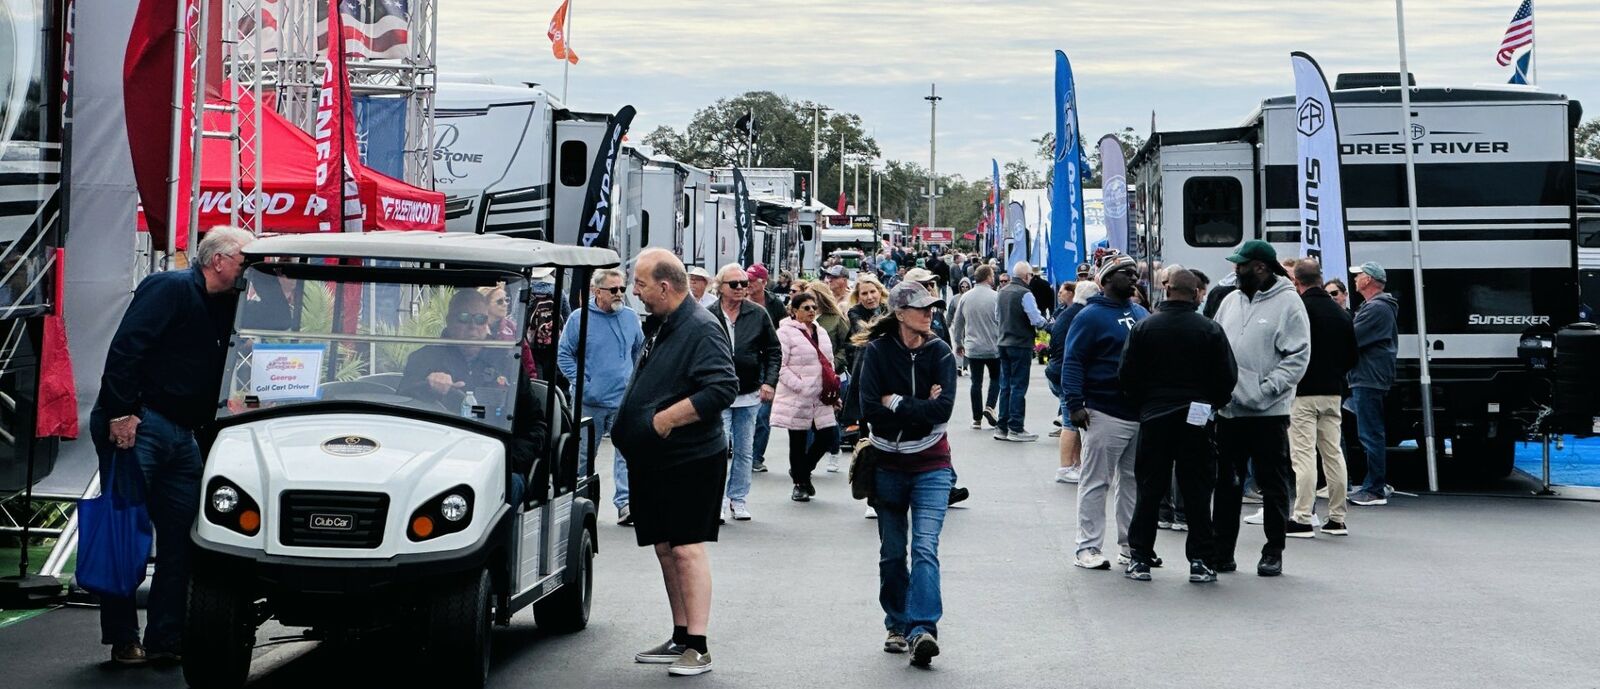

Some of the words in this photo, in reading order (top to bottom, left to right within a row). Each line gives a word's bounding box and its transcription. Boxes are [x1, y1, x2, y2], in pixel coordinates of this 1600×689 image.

[314, 59, 333, 231] GENERA
[1340, 143, 1424, 155] OREST
[1430, 142, 1509, 154] RIVER
[582, 122, 622, 248] AZYDAYS
[198, 191, 295, 215] WOOD
[391, 198, 432, 224] FLEETWOOD
[430, 203, 441, 225] RV
[1064, 161, 1079, 264] Jayco
[256, 385, 270, 393] Golf
[271, 383, 286, 391] Cart
[288, 382, 309, 390] Driver
[314, 517, 333, 527] Club
[333, 517, 349, 527] Car
